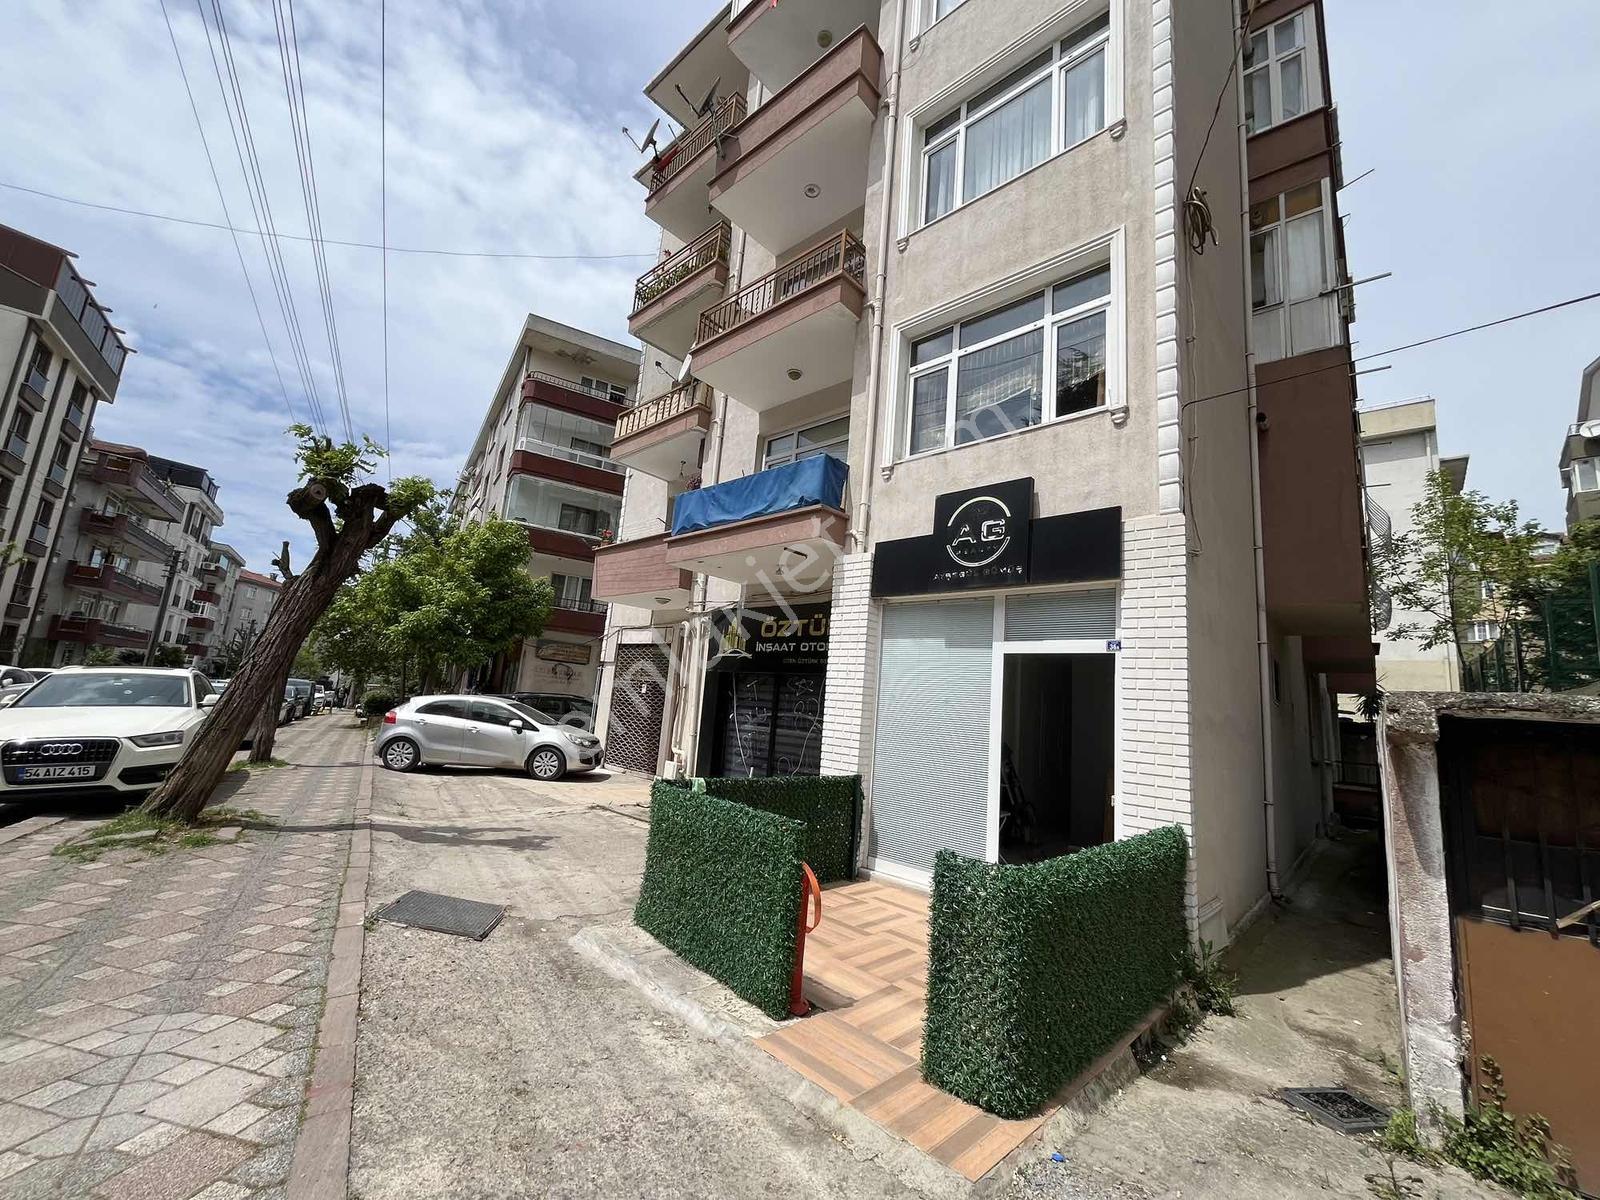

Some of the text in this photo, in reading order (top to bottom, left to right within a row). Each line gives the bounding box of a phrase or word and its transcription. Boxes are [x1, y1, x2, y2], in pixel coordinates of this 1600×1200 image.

[952, 519, 1005, 546] AG
[761, 614, 829, 637] ÖZTÜ
[755, 641, 829, 653] İNŞAAT OTO
[25, 766, 91, 778] 54 AIZ 415
